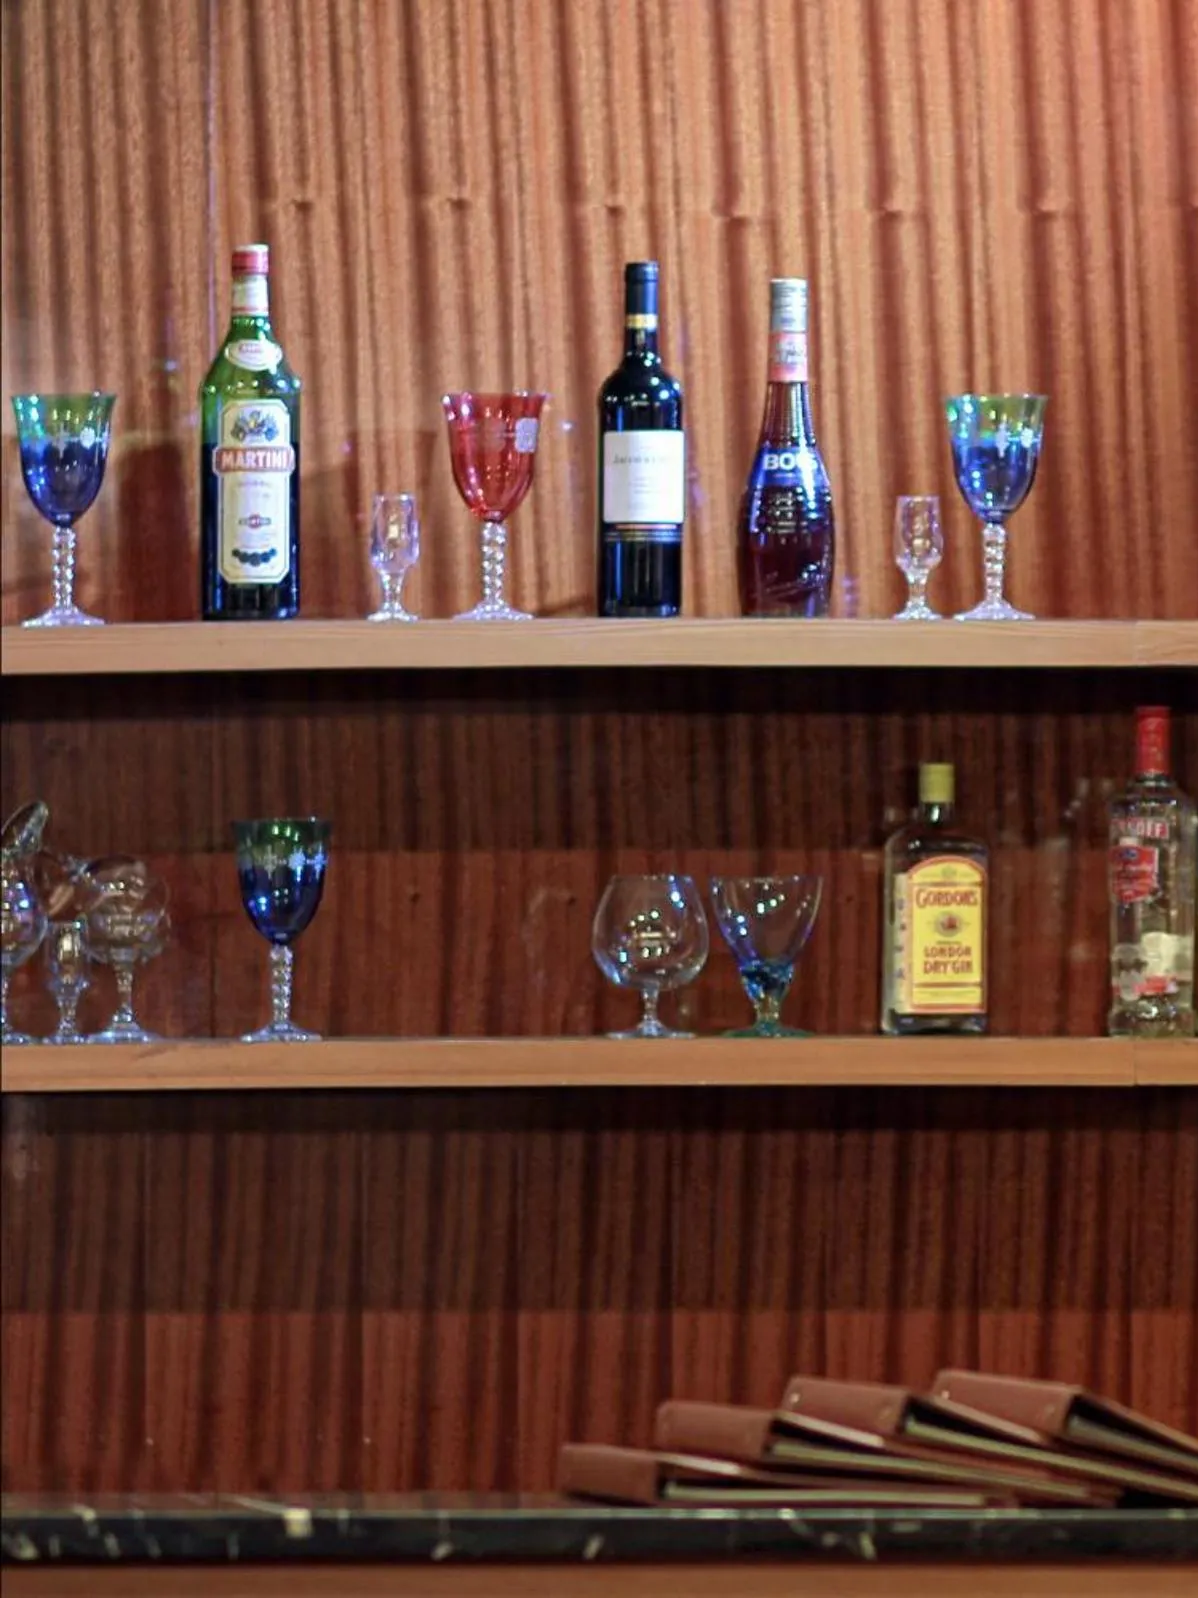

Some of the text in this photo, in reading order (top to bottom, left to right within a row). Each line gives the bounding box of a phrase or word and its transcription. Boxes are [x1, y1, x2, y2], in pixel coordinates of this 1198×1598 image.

[221, 449, 288, 469] MARTINI
[763, 453, 818, 470] BOS
[924, 946, 972, 957] LONDON
[923, 960, 973, 975] DRY GIN
